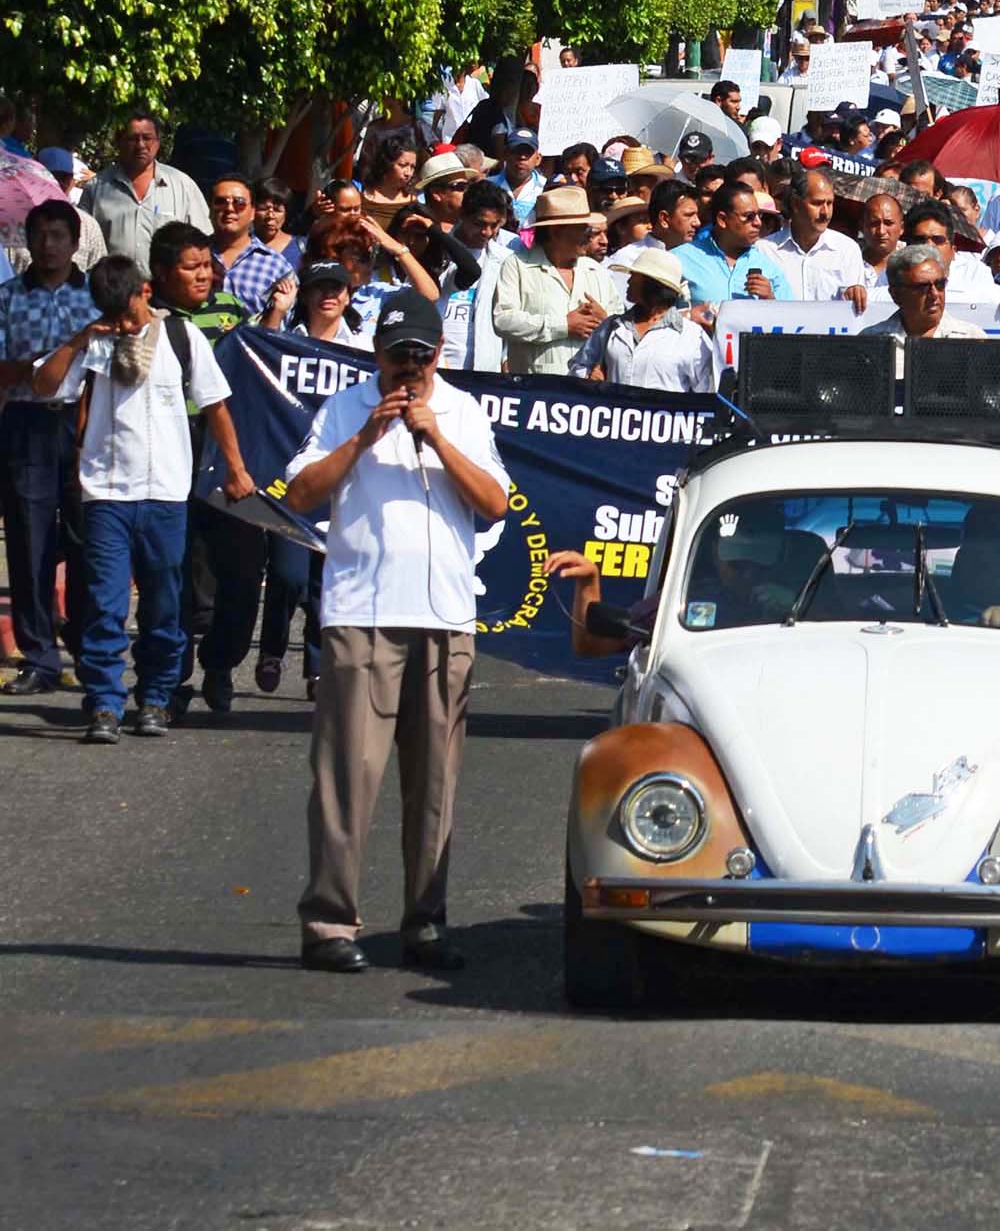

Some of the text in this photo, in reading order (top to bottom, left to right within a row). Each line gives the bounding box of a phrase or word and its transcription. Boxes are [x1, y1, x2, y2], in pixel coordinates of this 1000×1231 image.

[481, 392, 522, 429] DE
[521, 512, 541, 528] Y
[584, 541, 657, 579] FER
